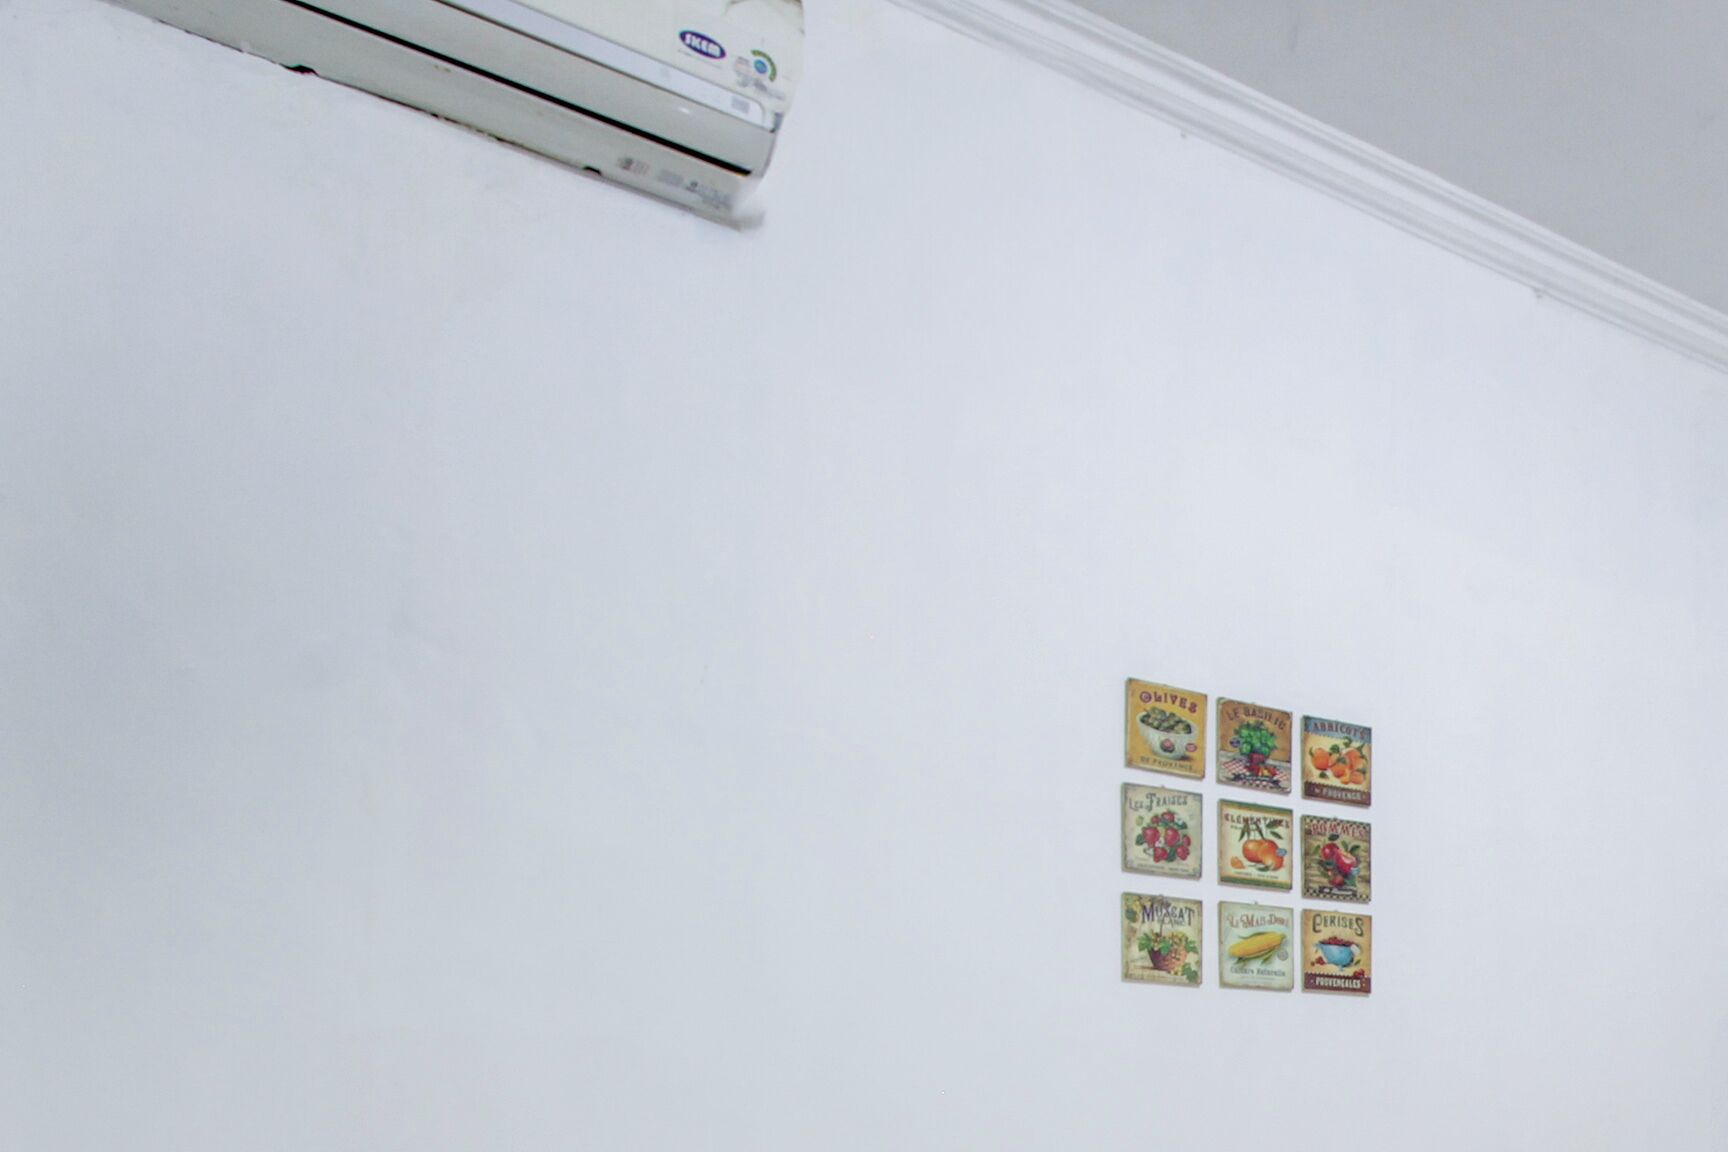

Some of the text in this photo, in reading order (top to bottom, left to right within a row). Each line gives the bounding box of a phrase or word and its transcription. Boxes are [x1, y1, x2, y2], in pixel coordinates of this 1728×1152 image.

[1139, 691, 1198, 713] OLIVES
[1311, 822, 1366, 838] POMMES
[1312, 913, 1364, 937] CERISES
